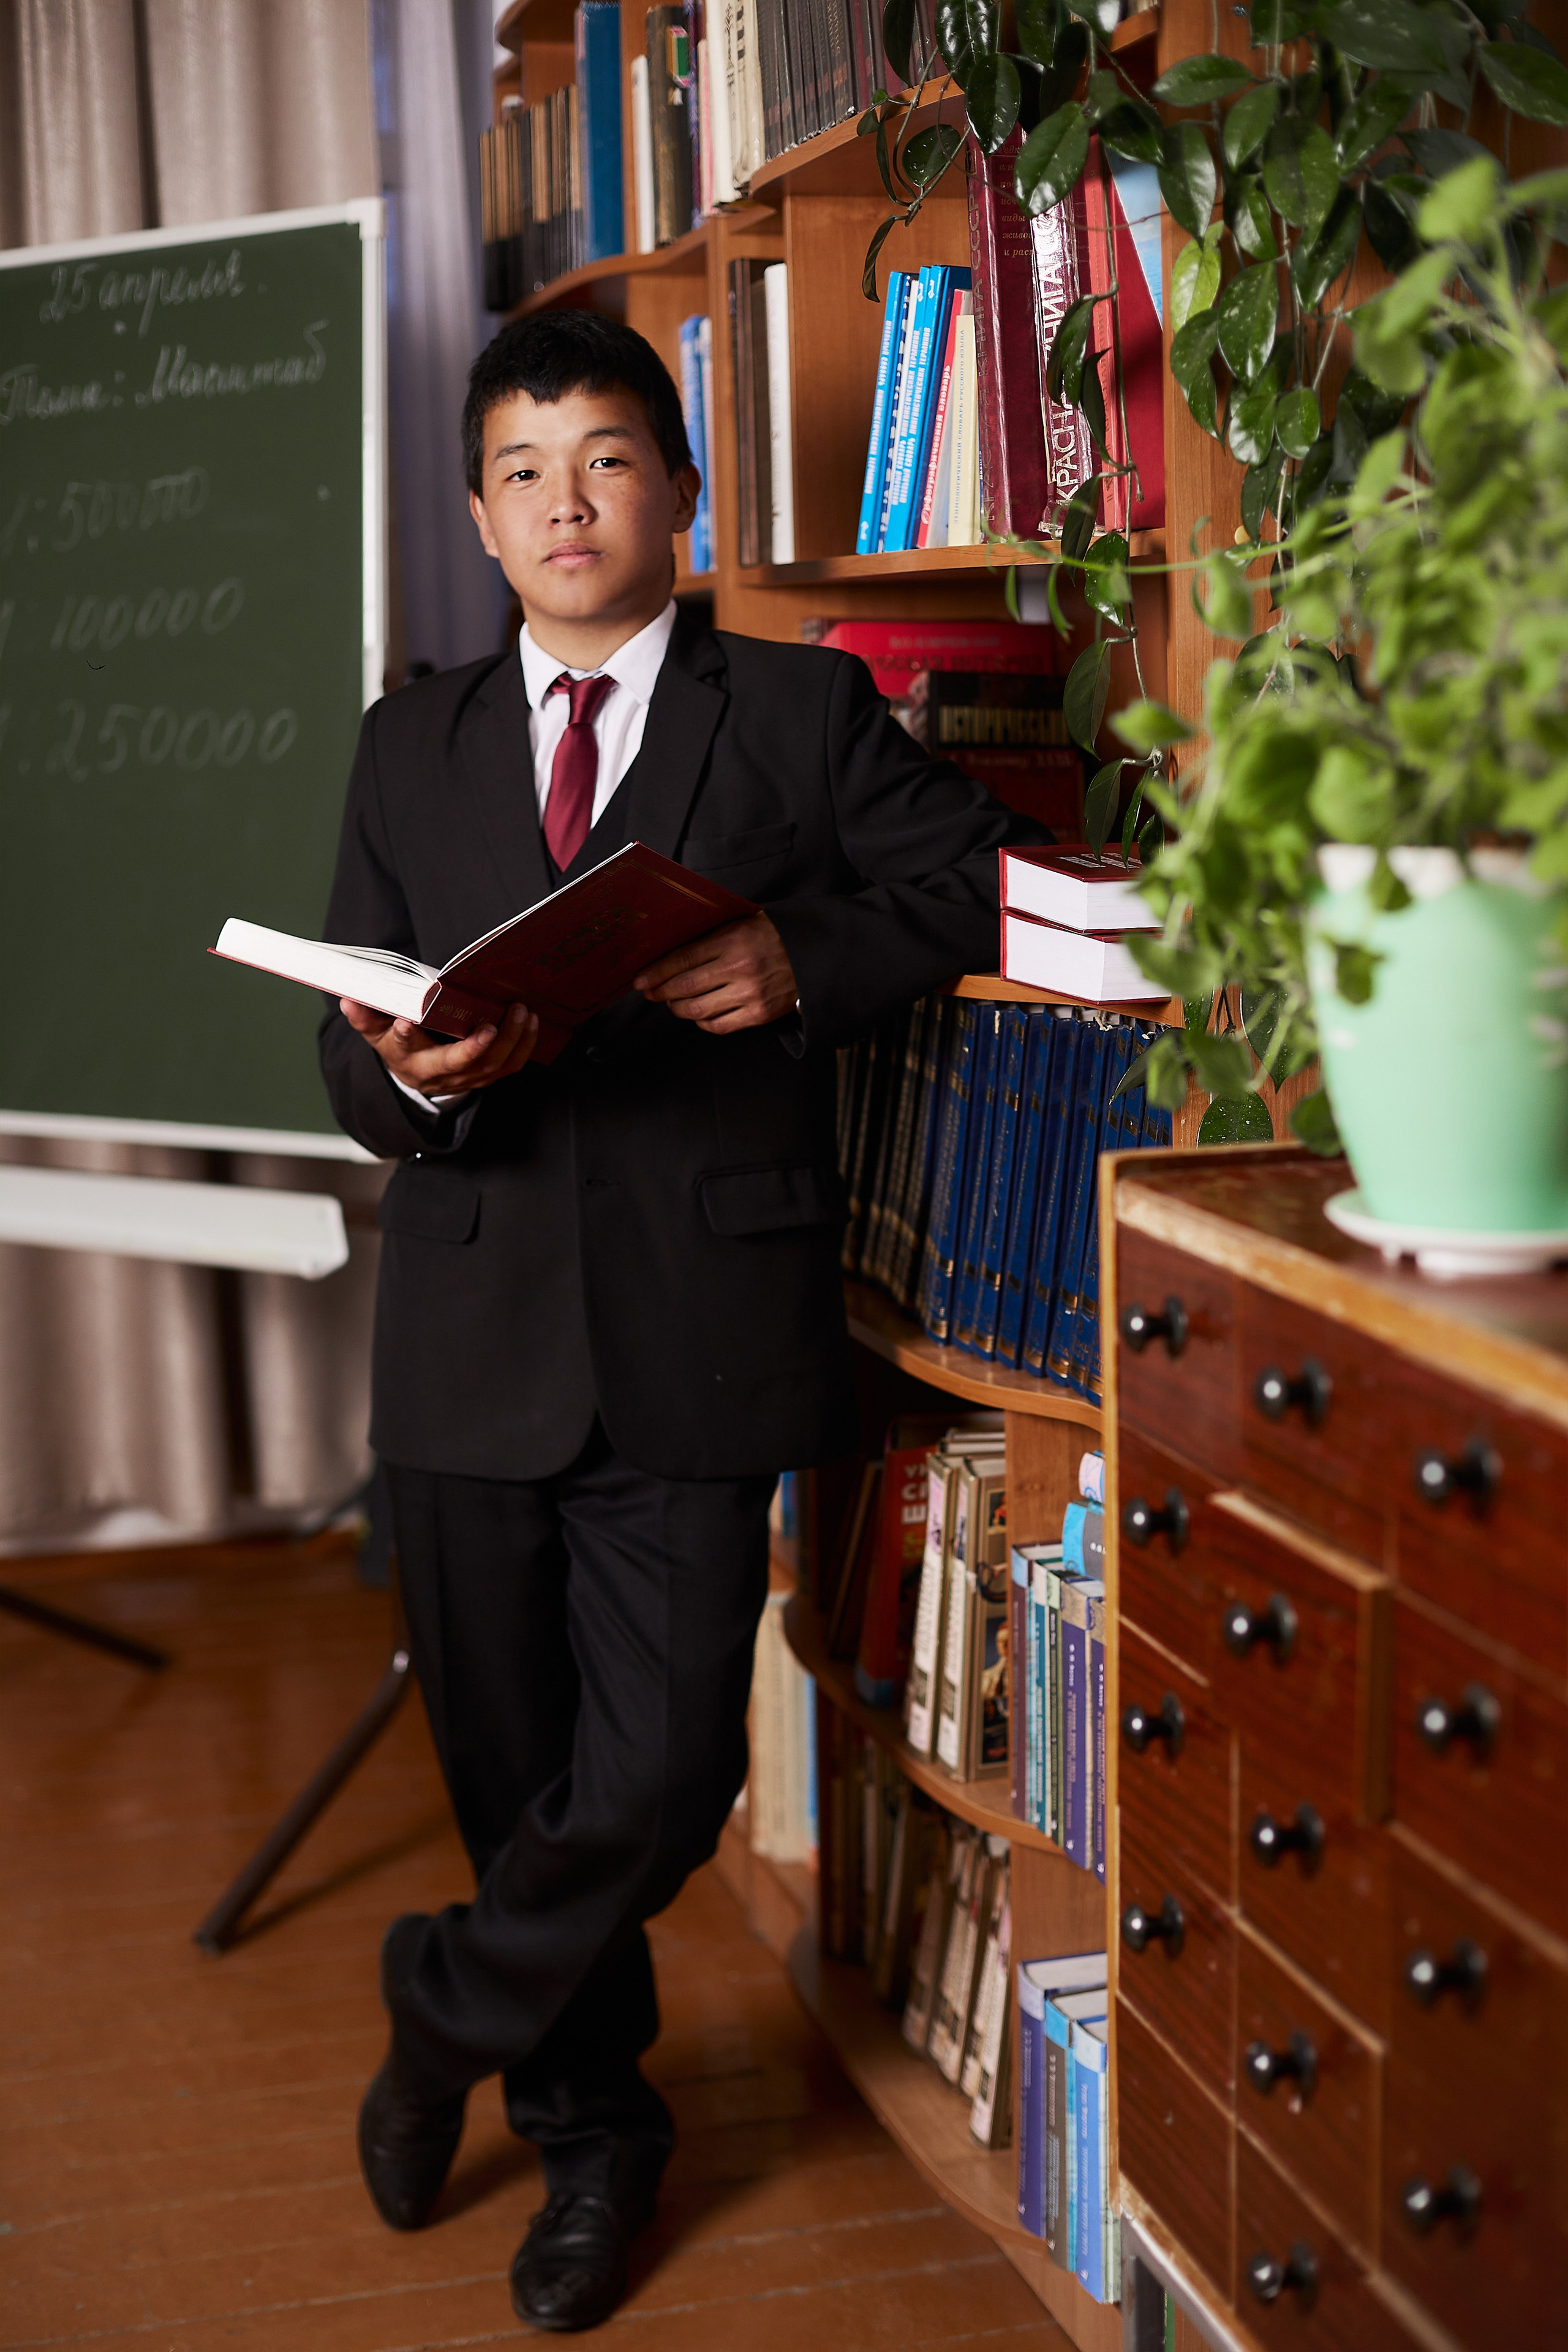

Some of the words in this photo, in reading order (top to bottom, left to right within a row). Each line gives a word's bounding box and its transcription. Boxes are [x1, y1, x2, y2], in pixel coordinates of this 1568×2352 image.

[969, 193, 981, 270] СССР
[1002, 213, 1026, 221] виды
[39, 262, 99, 323] 25
[1039, 262, 1066, 352] НИГА
[909, 330, 920, 368] ТЕРМИНОВ
[919, 327, 930, 365] ТЕРМИНОВ
[973, 279, 987, 377] КНИГА
[901, 370, 915, 437] ЛИНГВИСТИЧЕСКИХ
[909, 367, 925, 435] ЛИНГВИСТИЧЕСКИХ
[896, 440, 907, 469] СЛОВАРЬ
[905, 437, 916, 467] СЛОВАРЬ
[921, 414, 943, 524] Орфографический
[938, 364, 951, 412] словарь
[1051, 390, 1079, 504] КРАСН
[892, 470, 902, 506] ШКОЛЬНЫЙ
[899, 467, 911, 503] ШКОЛЬНЫЙ
[954, 442, 963, 523] ЭТИМОЛОГИЧЕСКИЙ
